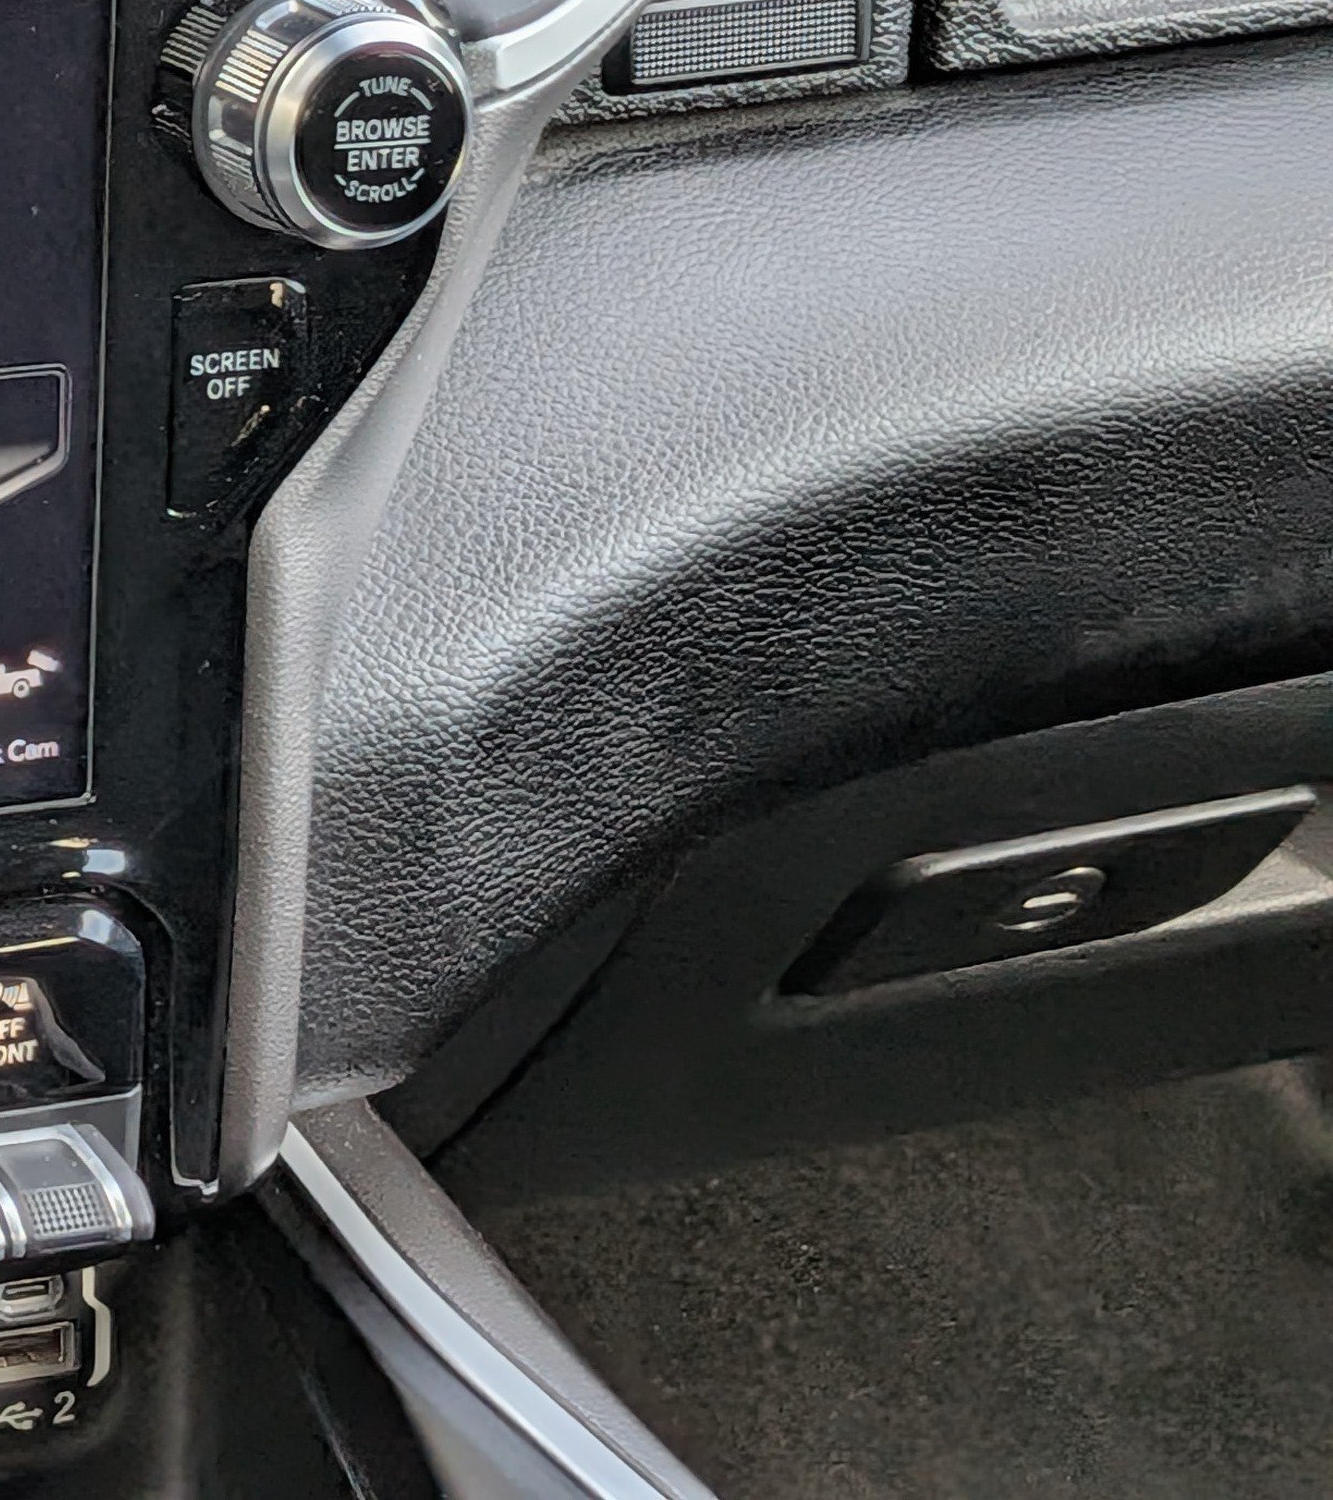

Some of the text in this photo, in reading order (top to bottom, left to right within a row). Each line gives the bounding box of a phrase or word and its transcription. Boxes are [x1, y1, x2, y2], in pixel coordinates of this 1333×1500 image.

[358, 76, 413, 99] TUNE
[336, 115, 432, 144] BROWSE
[346, 146, 419, 173] ENTER
[344, 178, 417, 204] SCROLL
[190, 348, 279, 376] SCREEN
[207, 376, 251, 400] OFF
[7, 737, 60, 762] Cam
[53, 1390, 76, 1423] 2
